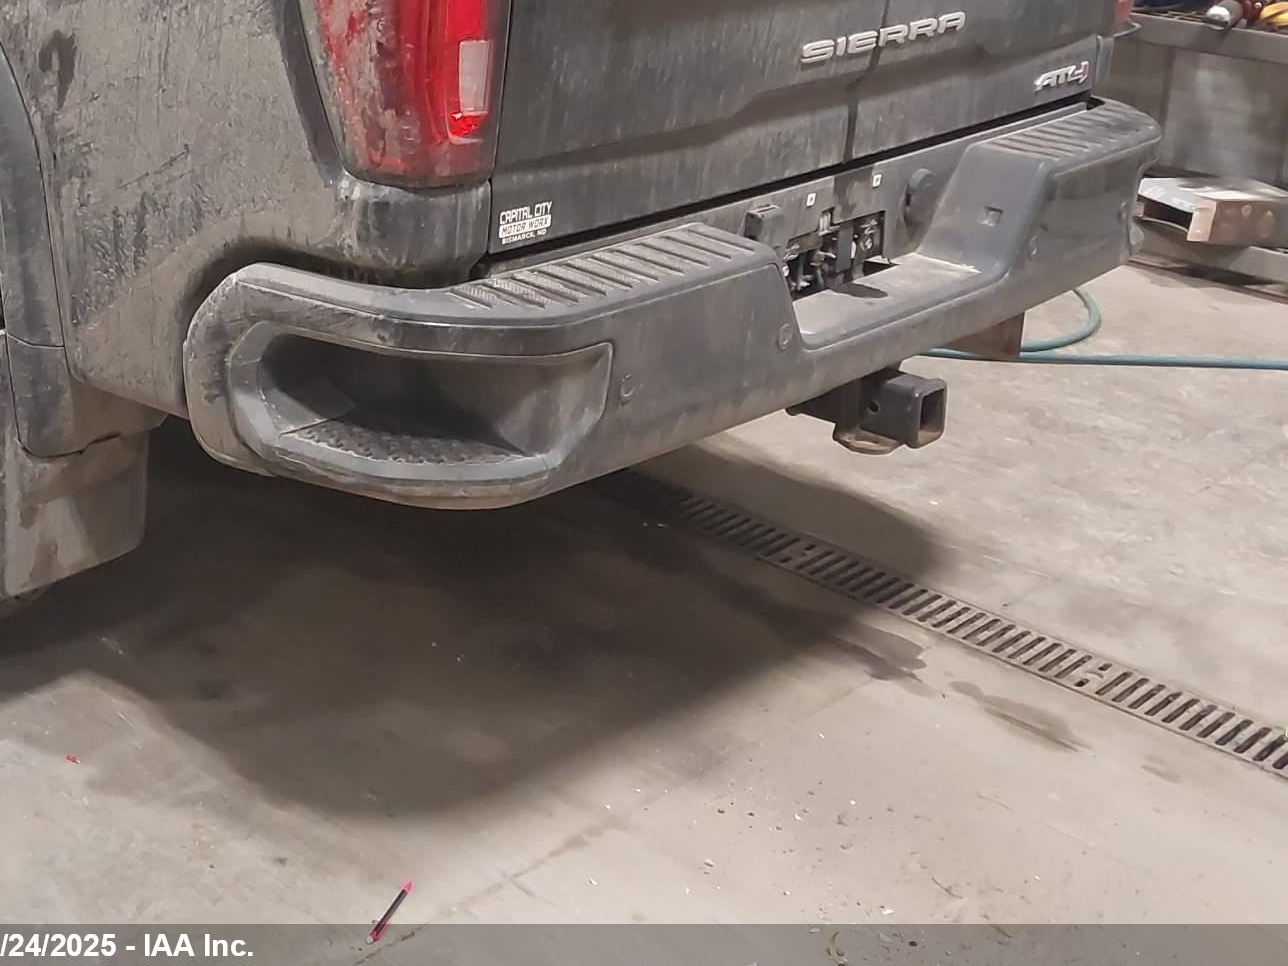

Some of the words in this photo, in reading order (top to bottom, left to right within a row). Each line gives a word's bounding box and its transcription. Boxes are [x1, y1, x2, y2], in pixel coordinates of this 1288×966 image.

[800, 10, 968, 64] SIERRA
[1033, 60, 1090, 92] AT4
[499, 205, 533, 225] CAPITAL
[534, 201, 553, 217] CITY
[501, 222, 526, 238] MOTOR
[528, 215, 550, 231] WORX
